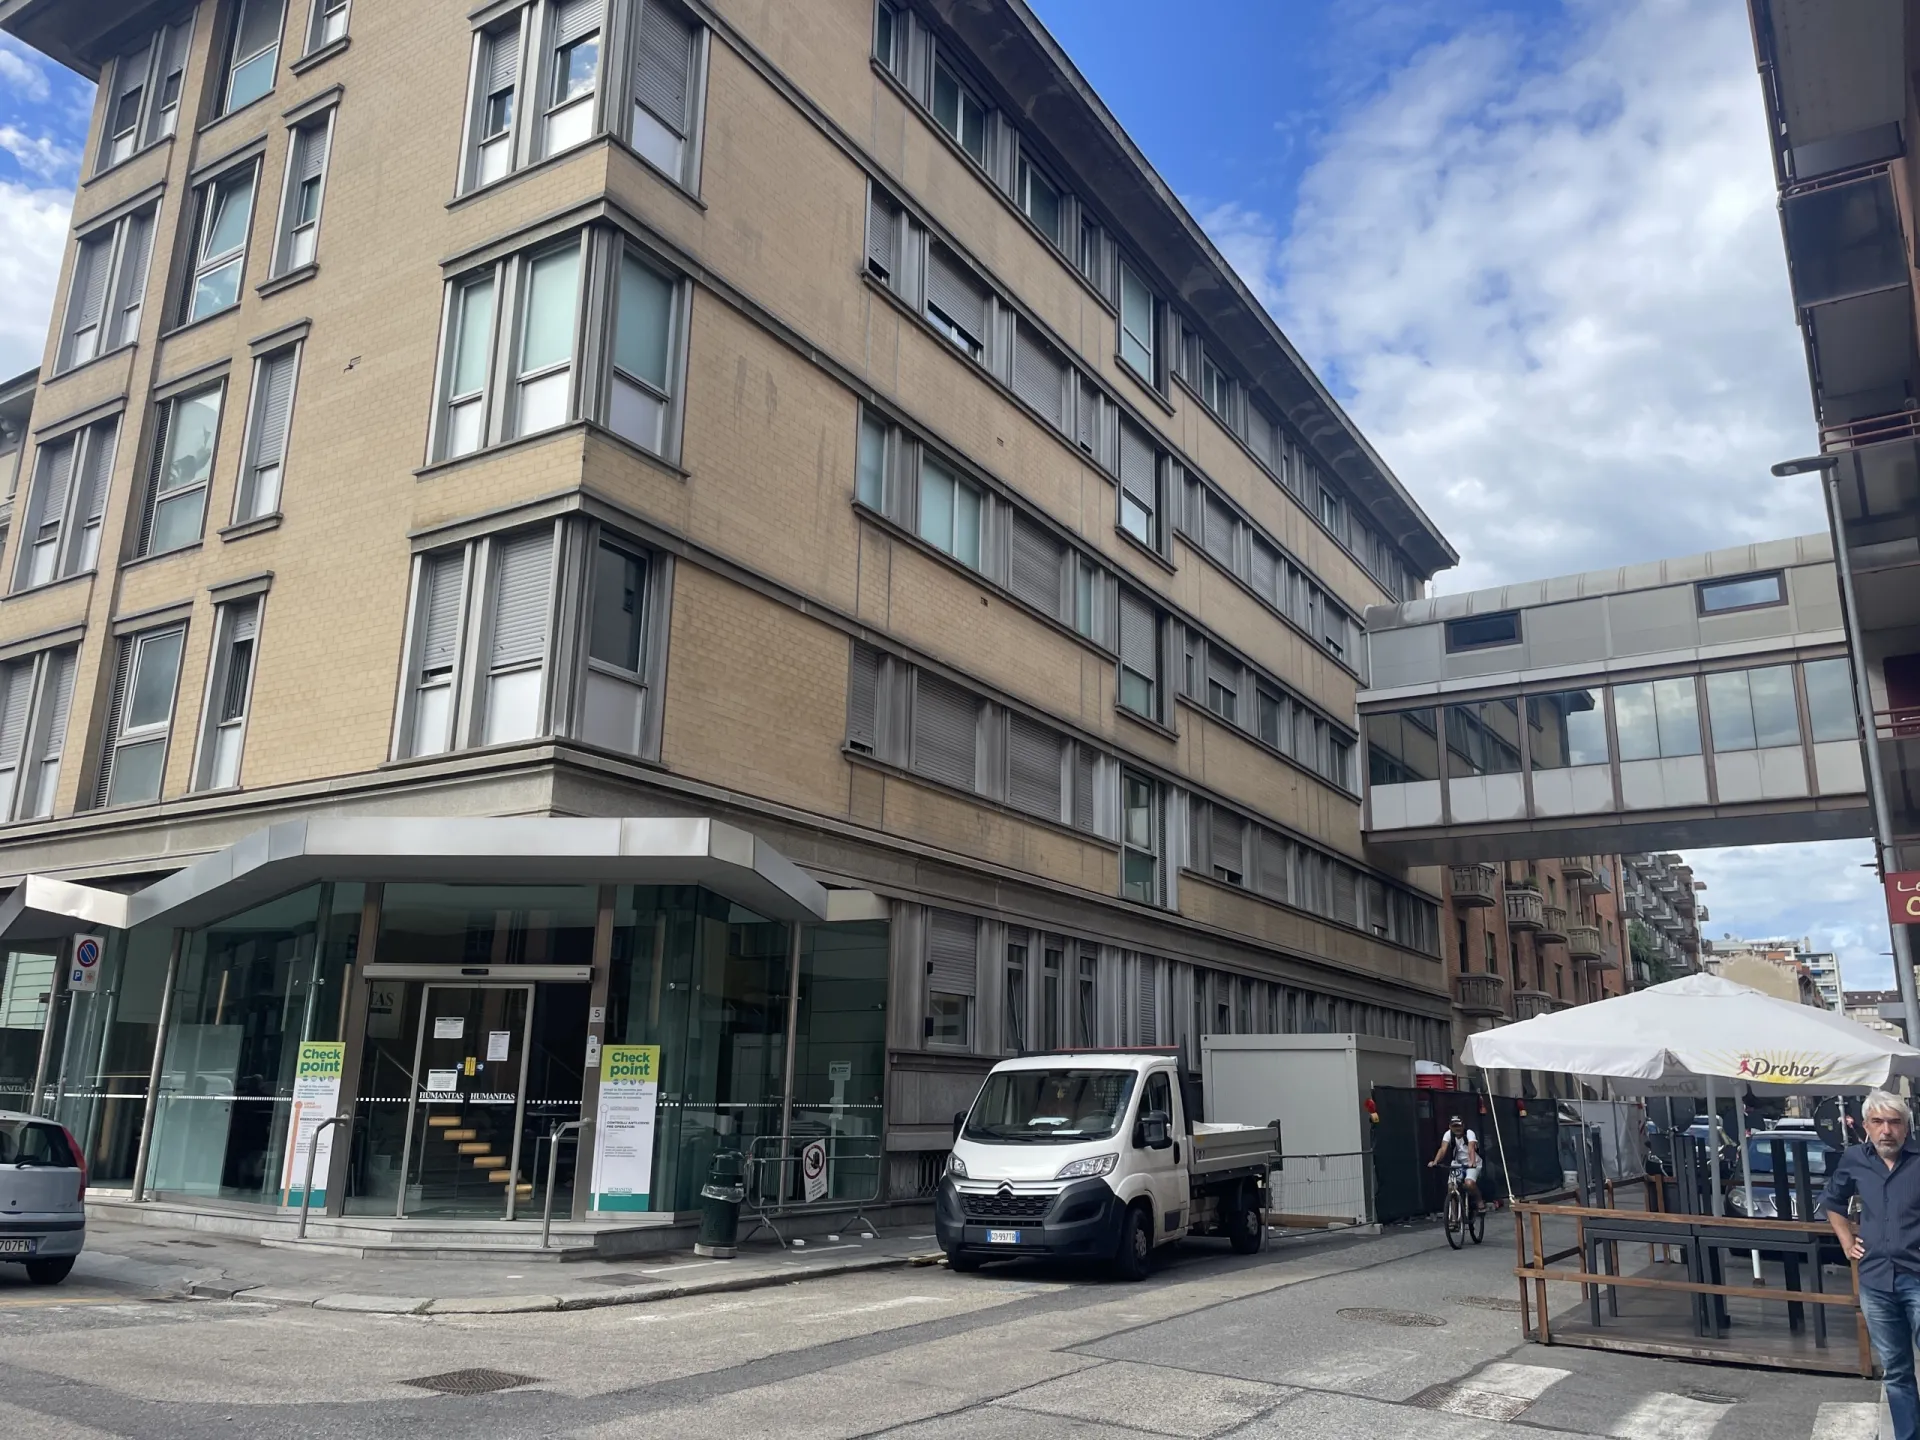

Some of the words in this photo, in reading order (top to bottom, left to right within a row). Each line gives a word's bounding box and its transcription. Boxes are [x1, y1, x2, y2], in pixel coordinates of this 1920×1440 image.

[594, 1009, 601, 1018] 5
[302, 1048, 341, 1059] Check
[611, 1052, 650, 1063] Check
[300, 1060, 341, 1074] point
[610, 1063, 650, 1077] point
[1752, 1057, 1820, 1077] Dreher
[419, 1091, 465, 1099] HUMANITAS
[470, 1092, 516, 1100] HUMANITAS
